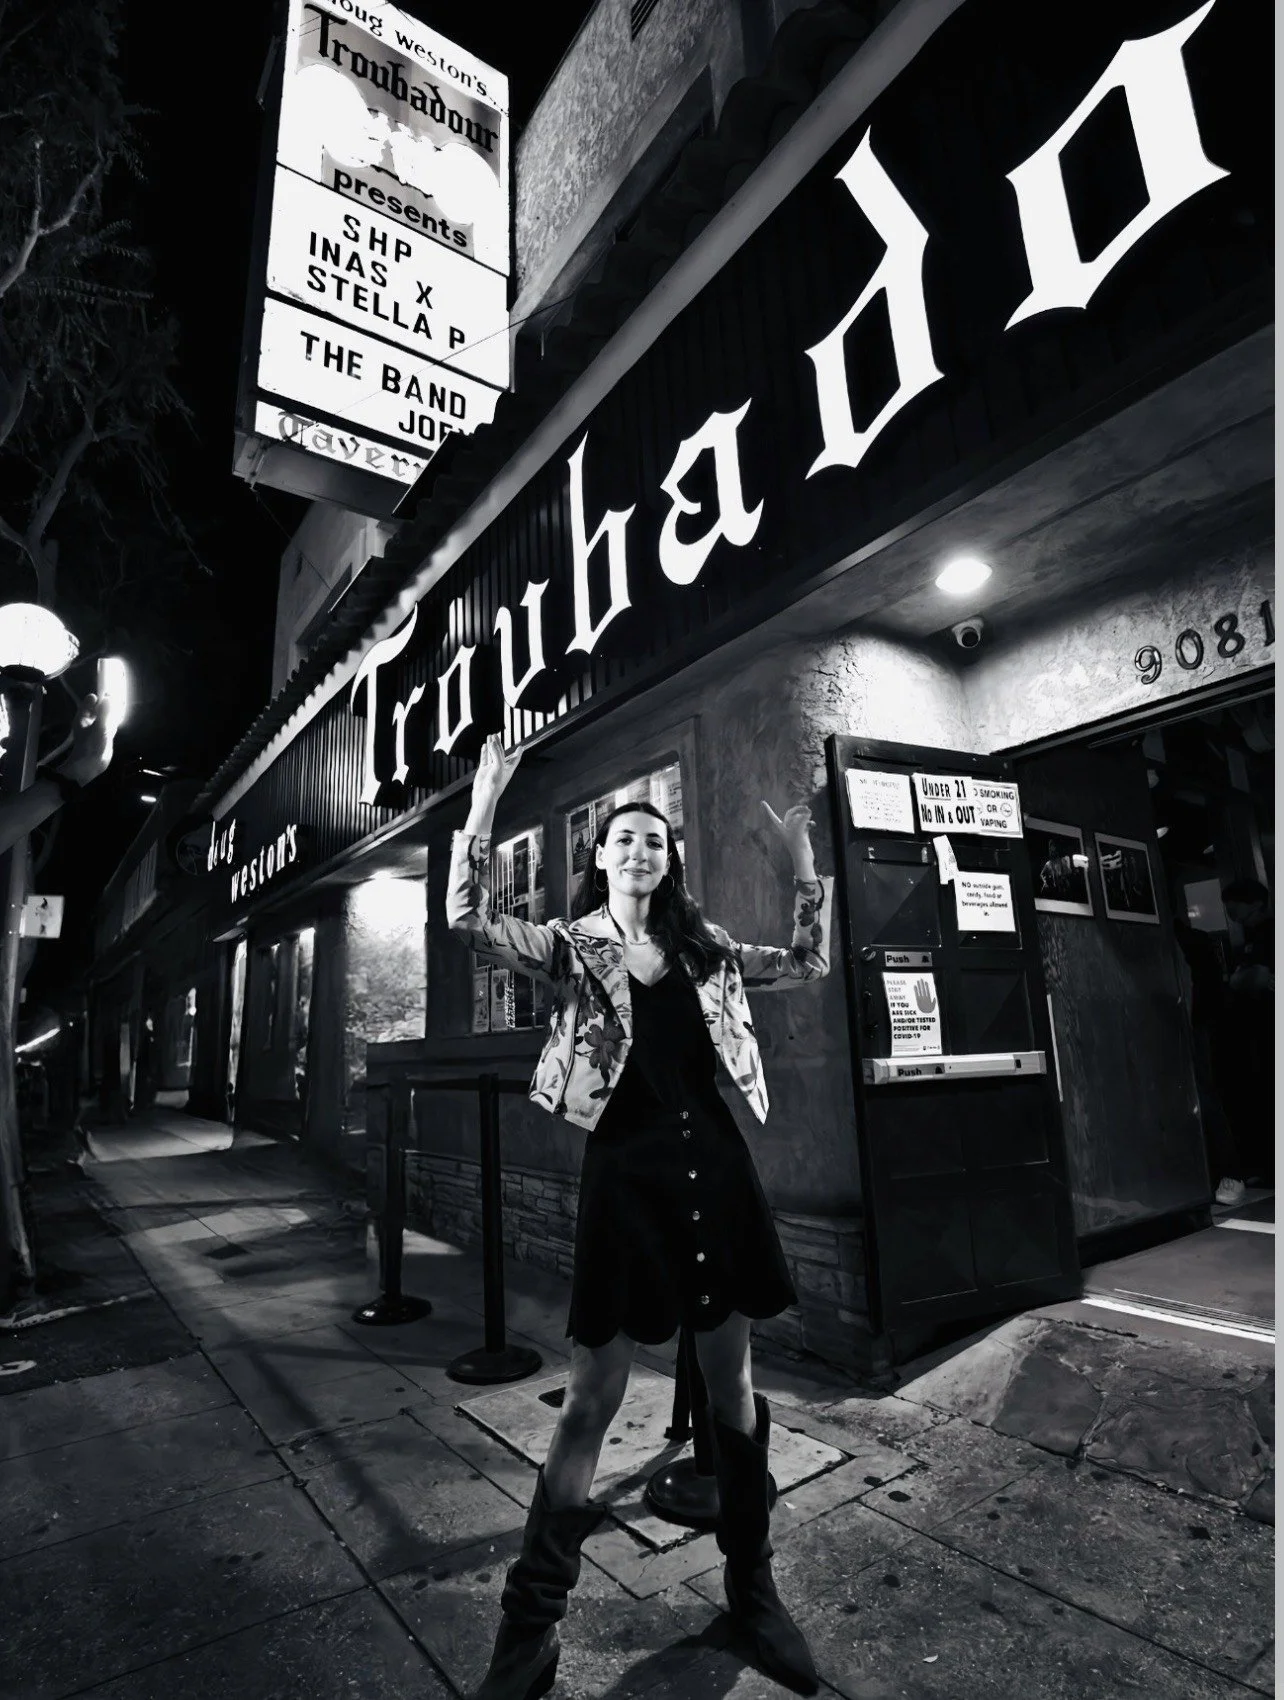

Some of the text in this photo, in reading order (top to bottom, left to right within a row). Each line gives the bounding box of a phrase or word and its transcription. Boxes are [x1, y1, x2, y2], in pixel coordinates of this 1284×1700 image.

[332, 0, 383, 36] oug
[303, 3, 498, 153] Troubadour
[334, 168, 467, 248] presents
[309, 231, 433, 310] INAS X
[306, 264, 465, 350] STELLA P
[300, 330, 466, 420] THE BAND
[350, 0, 1232, 807] Troubado
[1134, 600, 1275, 685] 9081
[955, 780, 967, 798] 21
[980, 788, 1015, 800] SMOKING
[934, 805, 946, 823] IN
[947, 811, 954, 824] &
[956, 805, 976, 824] OUT
[980, 818, 1008, 829] VAPING
[986, 804, 998, 813] OR
[886, 955, 910, 963] Push
[897, 1067, 922, 1077] Push
